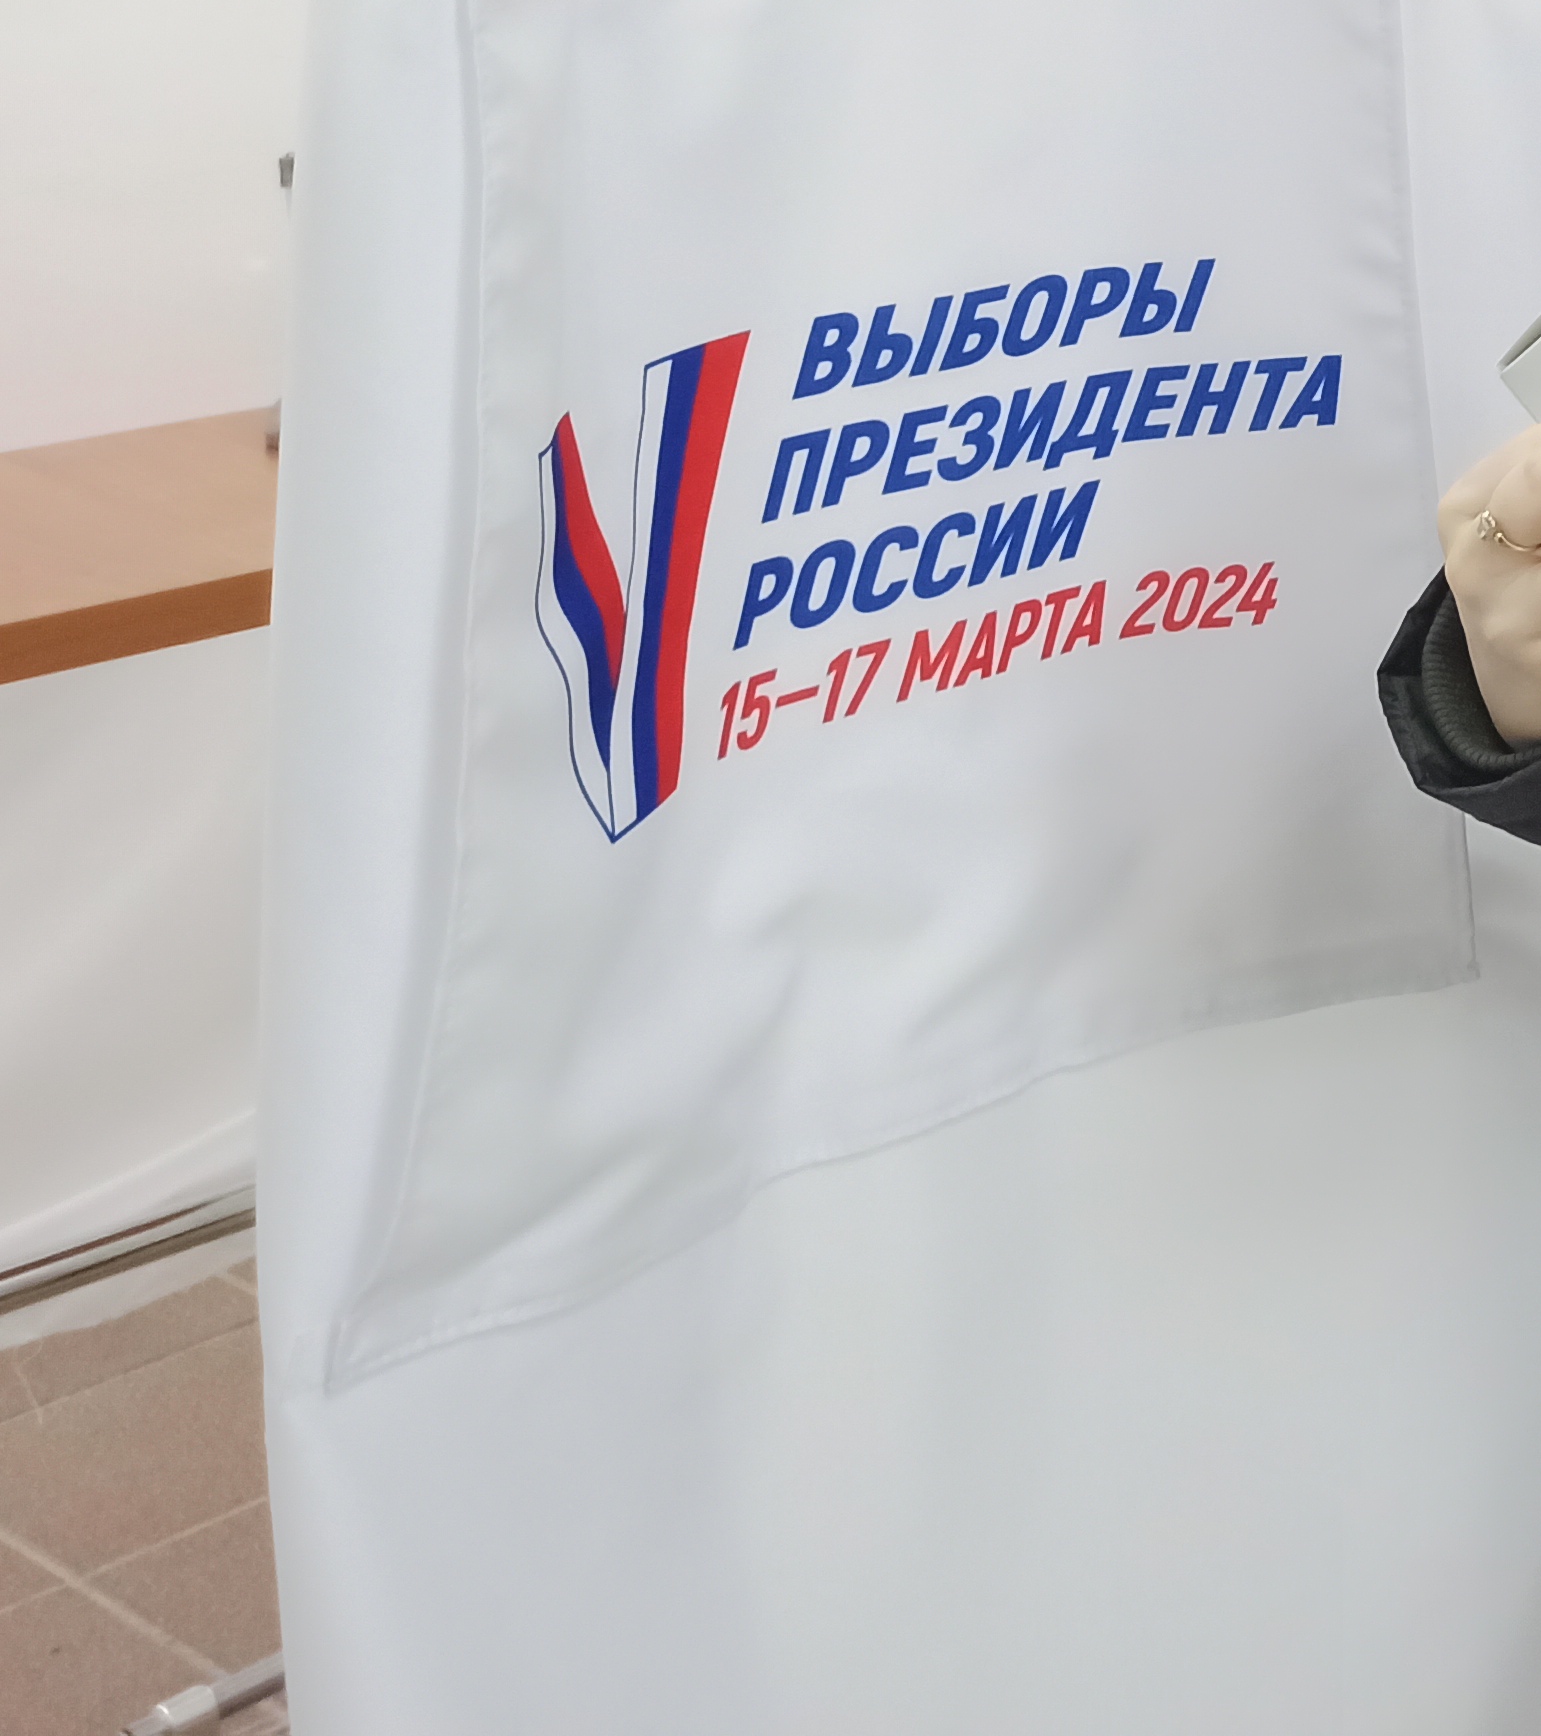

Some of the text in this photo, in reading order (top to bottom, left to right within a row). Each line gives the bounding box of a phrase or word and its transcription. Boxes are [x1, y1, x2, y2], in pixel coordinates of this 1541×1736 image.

[792, 258, 1216, 400] ВЫБОРЫ
[761, 354, 1343, 524] ПРЕЗИДЕНТА
[733, 479, 1101, 650] РОССИИ
[897, 580, 1106, 702] МАРТА
[1119, 562, 1279, 640] 2024
